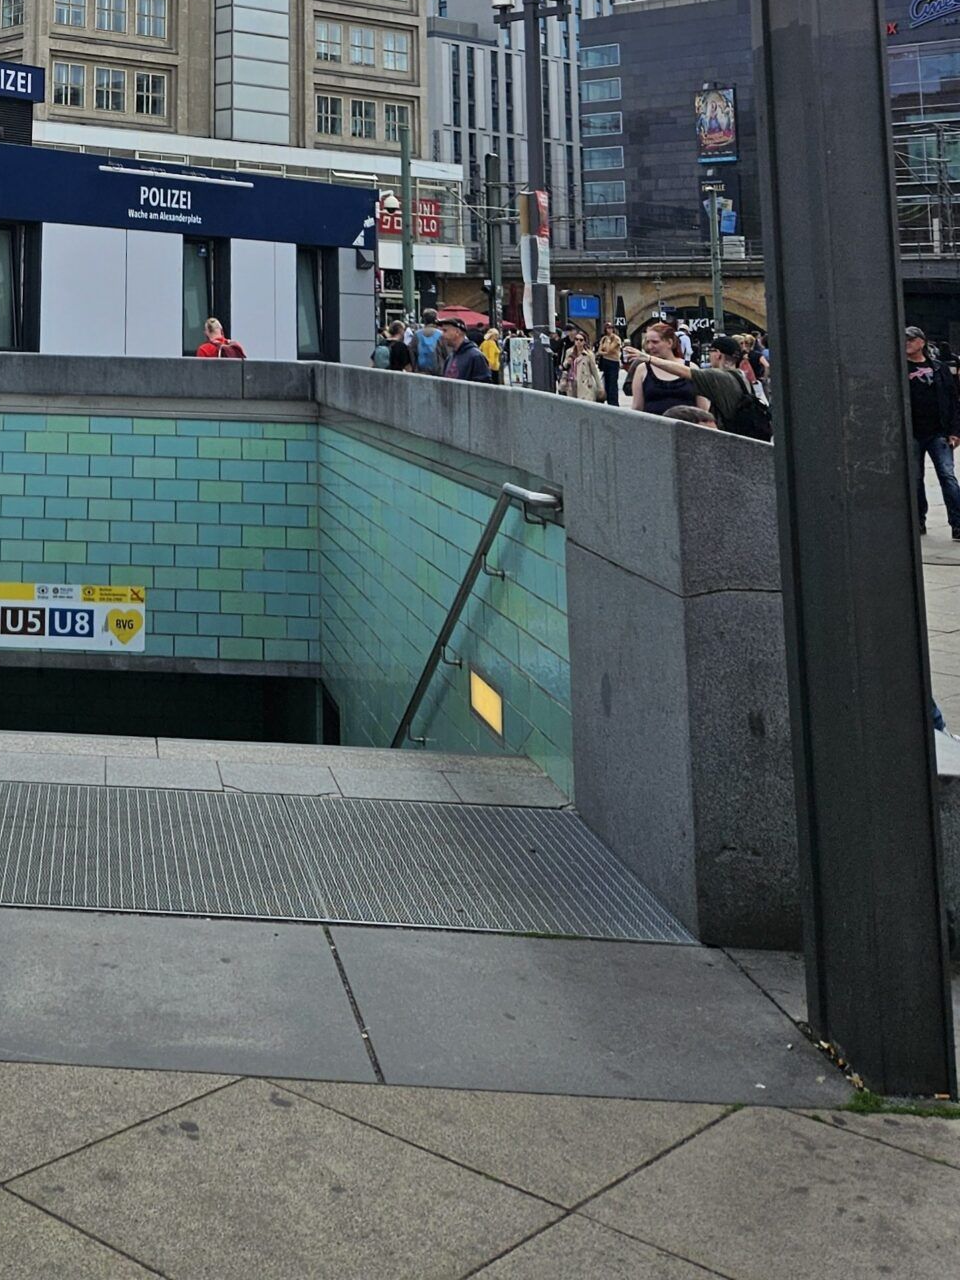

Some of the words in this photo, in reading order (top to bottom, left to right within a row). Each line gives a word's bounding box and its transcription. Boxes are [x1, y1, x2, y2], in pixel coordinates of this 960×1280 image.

[140, 186, 192, 210] POLIZEI
[128, 209, 149, 220] Wache
[149, 212, 159, 220] am
[159, 211, 202, 225] Alexanderplatz
[581, 301, 588, 310] U
[6, 609, 41, 633] U5
[54, 611, 90, 635] U8
[115, 618, 134, 630] BVG
